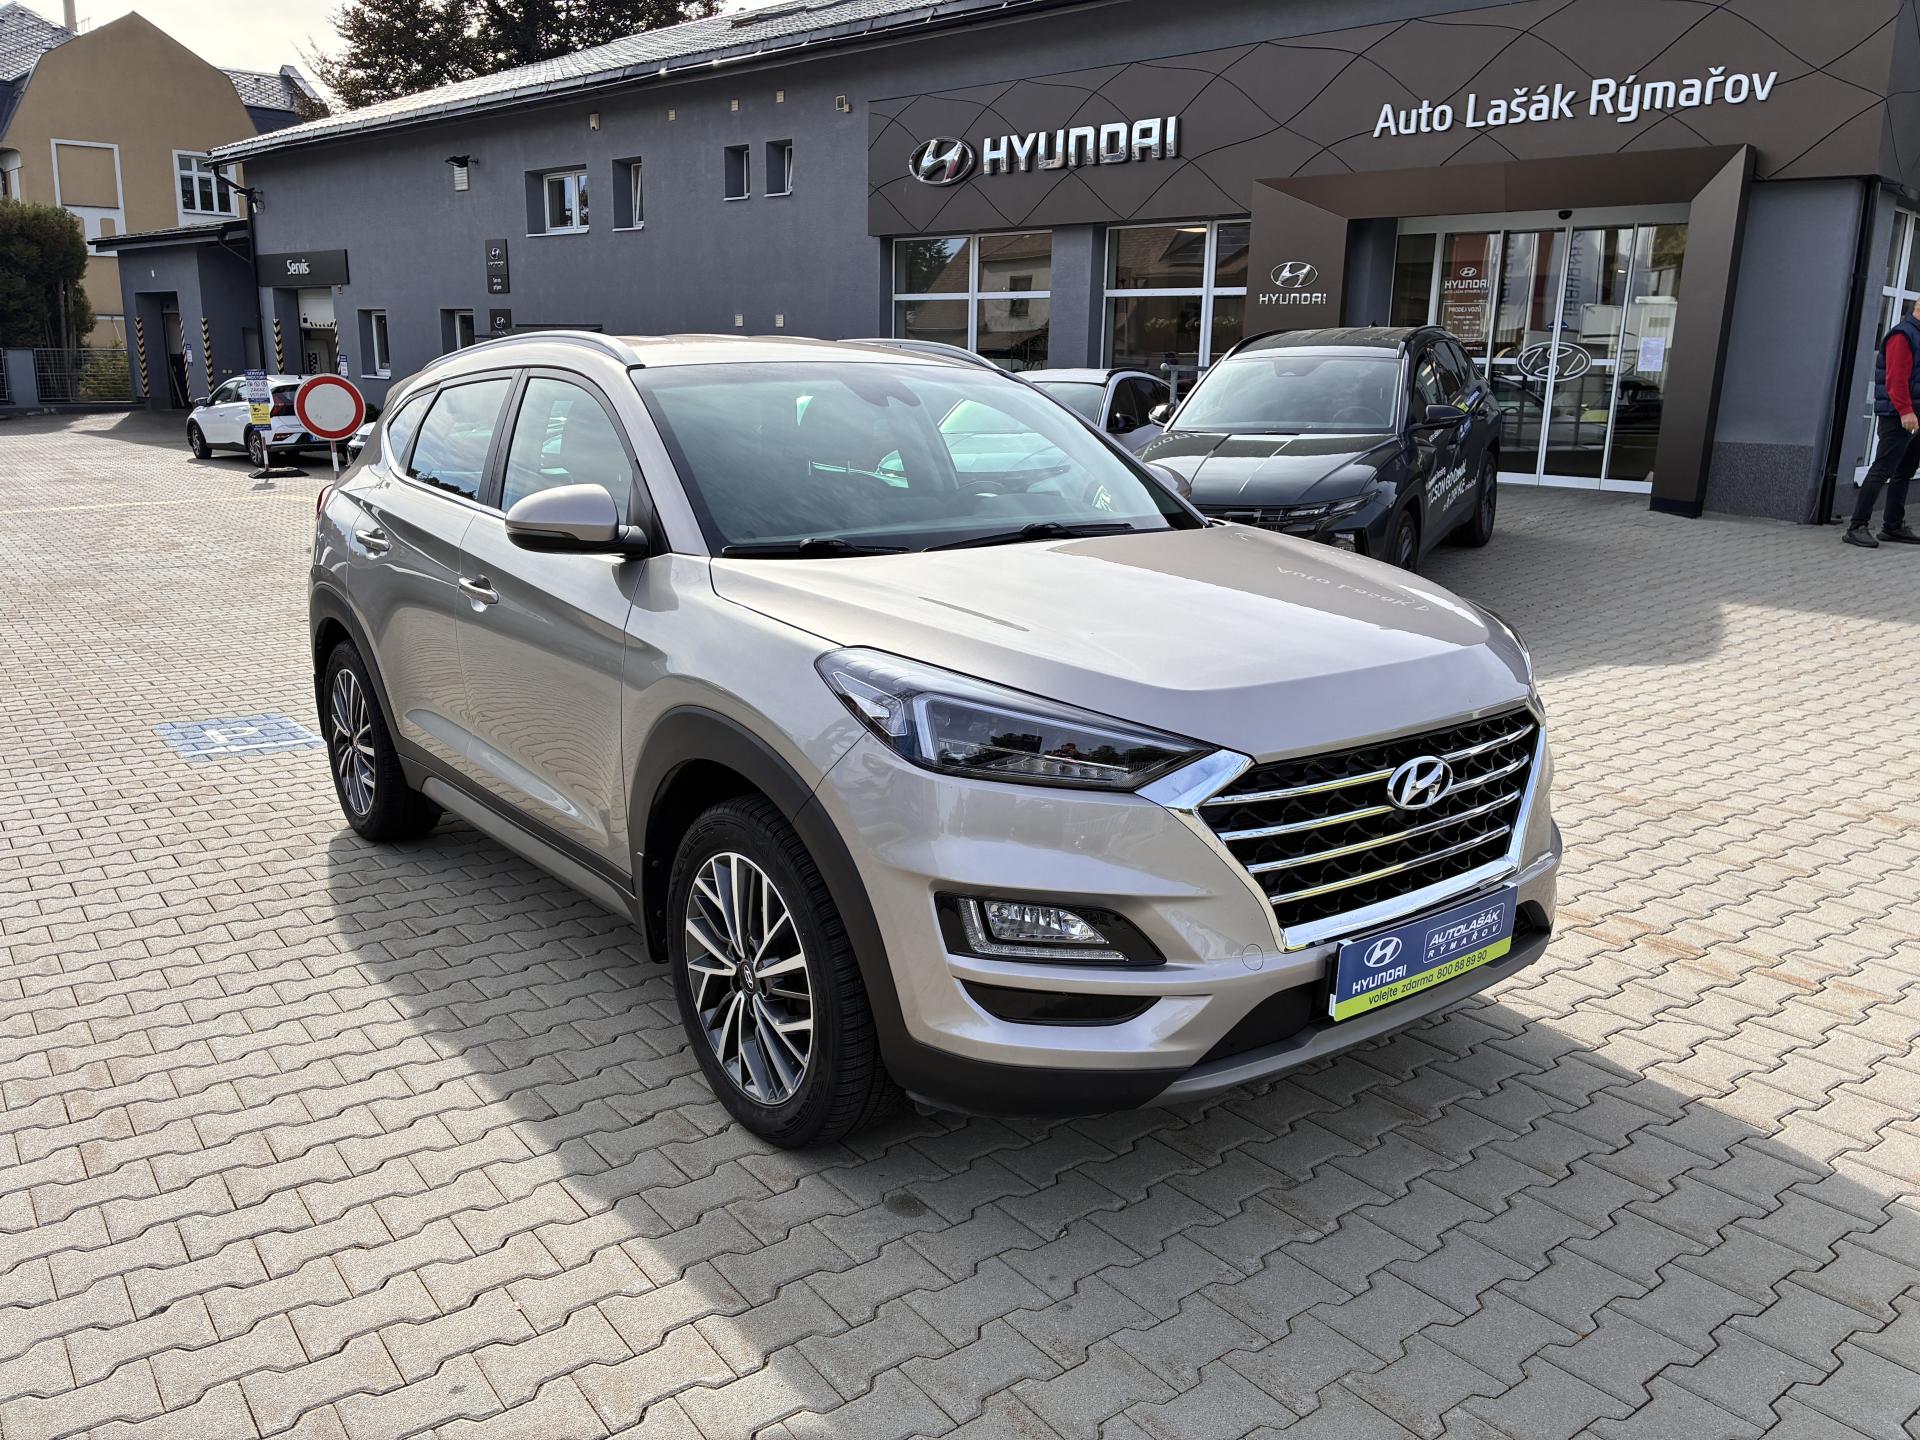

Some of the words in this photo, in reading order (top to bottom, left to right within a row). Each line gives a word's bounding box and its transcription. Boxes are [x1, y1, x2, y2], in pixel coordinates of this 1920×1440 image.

[1373, 100, 1453, 138] Auto
[1466, 83, 1577, 128] Lašák
[1588, 66, 1778, 123] Rýmařov
[983, 116, 1179, 175] HYUNDAI
[286, 259, 310, 275] Servis
[1444, 279, 1490, 289] HYUNDAI
[1259, 293, 1327, 304] HYUNDAI
[1427, 924, 1499, 958] RÝMAŘOV
[1429, 907, 1500, 946] AUTOLAŠÁK
[1351, 964, 1407, 994] HYUNDAI
[1368, 987, 1398, 1005] volejte
[1401, 973, 1434, 993] zdarma
[1436, 965, 1453, 980] 800
[1454, 959, 1465, 972] 88
[1465, 956, 1476, 968] 89
[1476, 950, 1488, 963] 90
